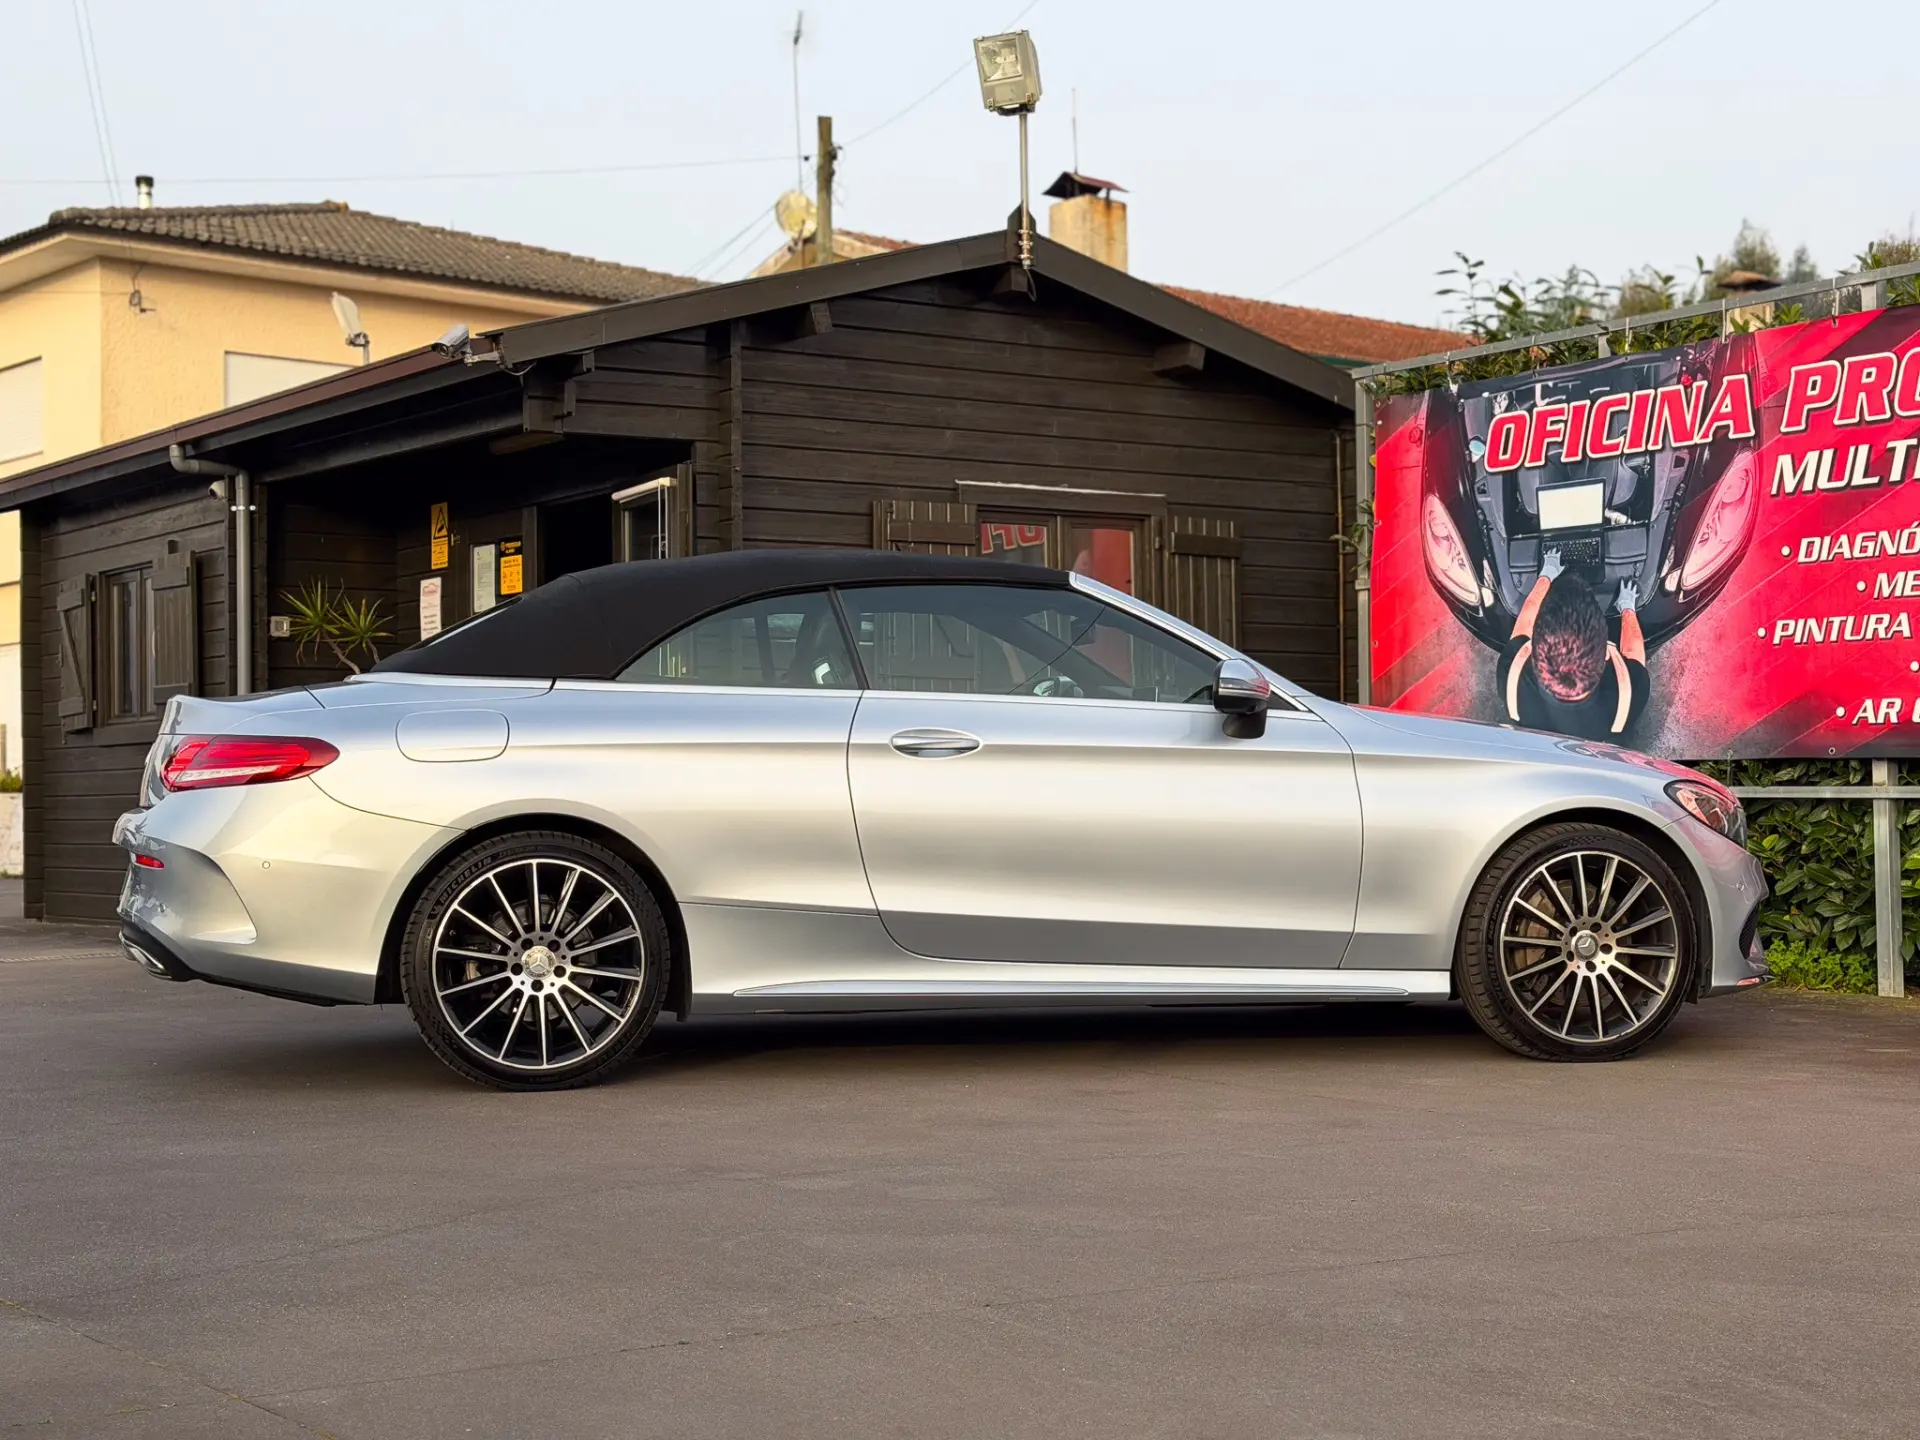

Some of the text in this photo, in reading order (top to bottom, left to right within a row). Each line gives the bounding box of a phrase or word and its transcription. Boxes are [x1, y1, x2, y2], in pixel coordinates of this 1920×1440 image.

[1484, 374, 1755, 473] OFICINA
[1770, 438, 1920, 496] MULT
[1773, 612, 1912, 645] PINTURA
[1852, 698, 1901, 724] AR
[438, 856, 492, 905] MICHELIN
